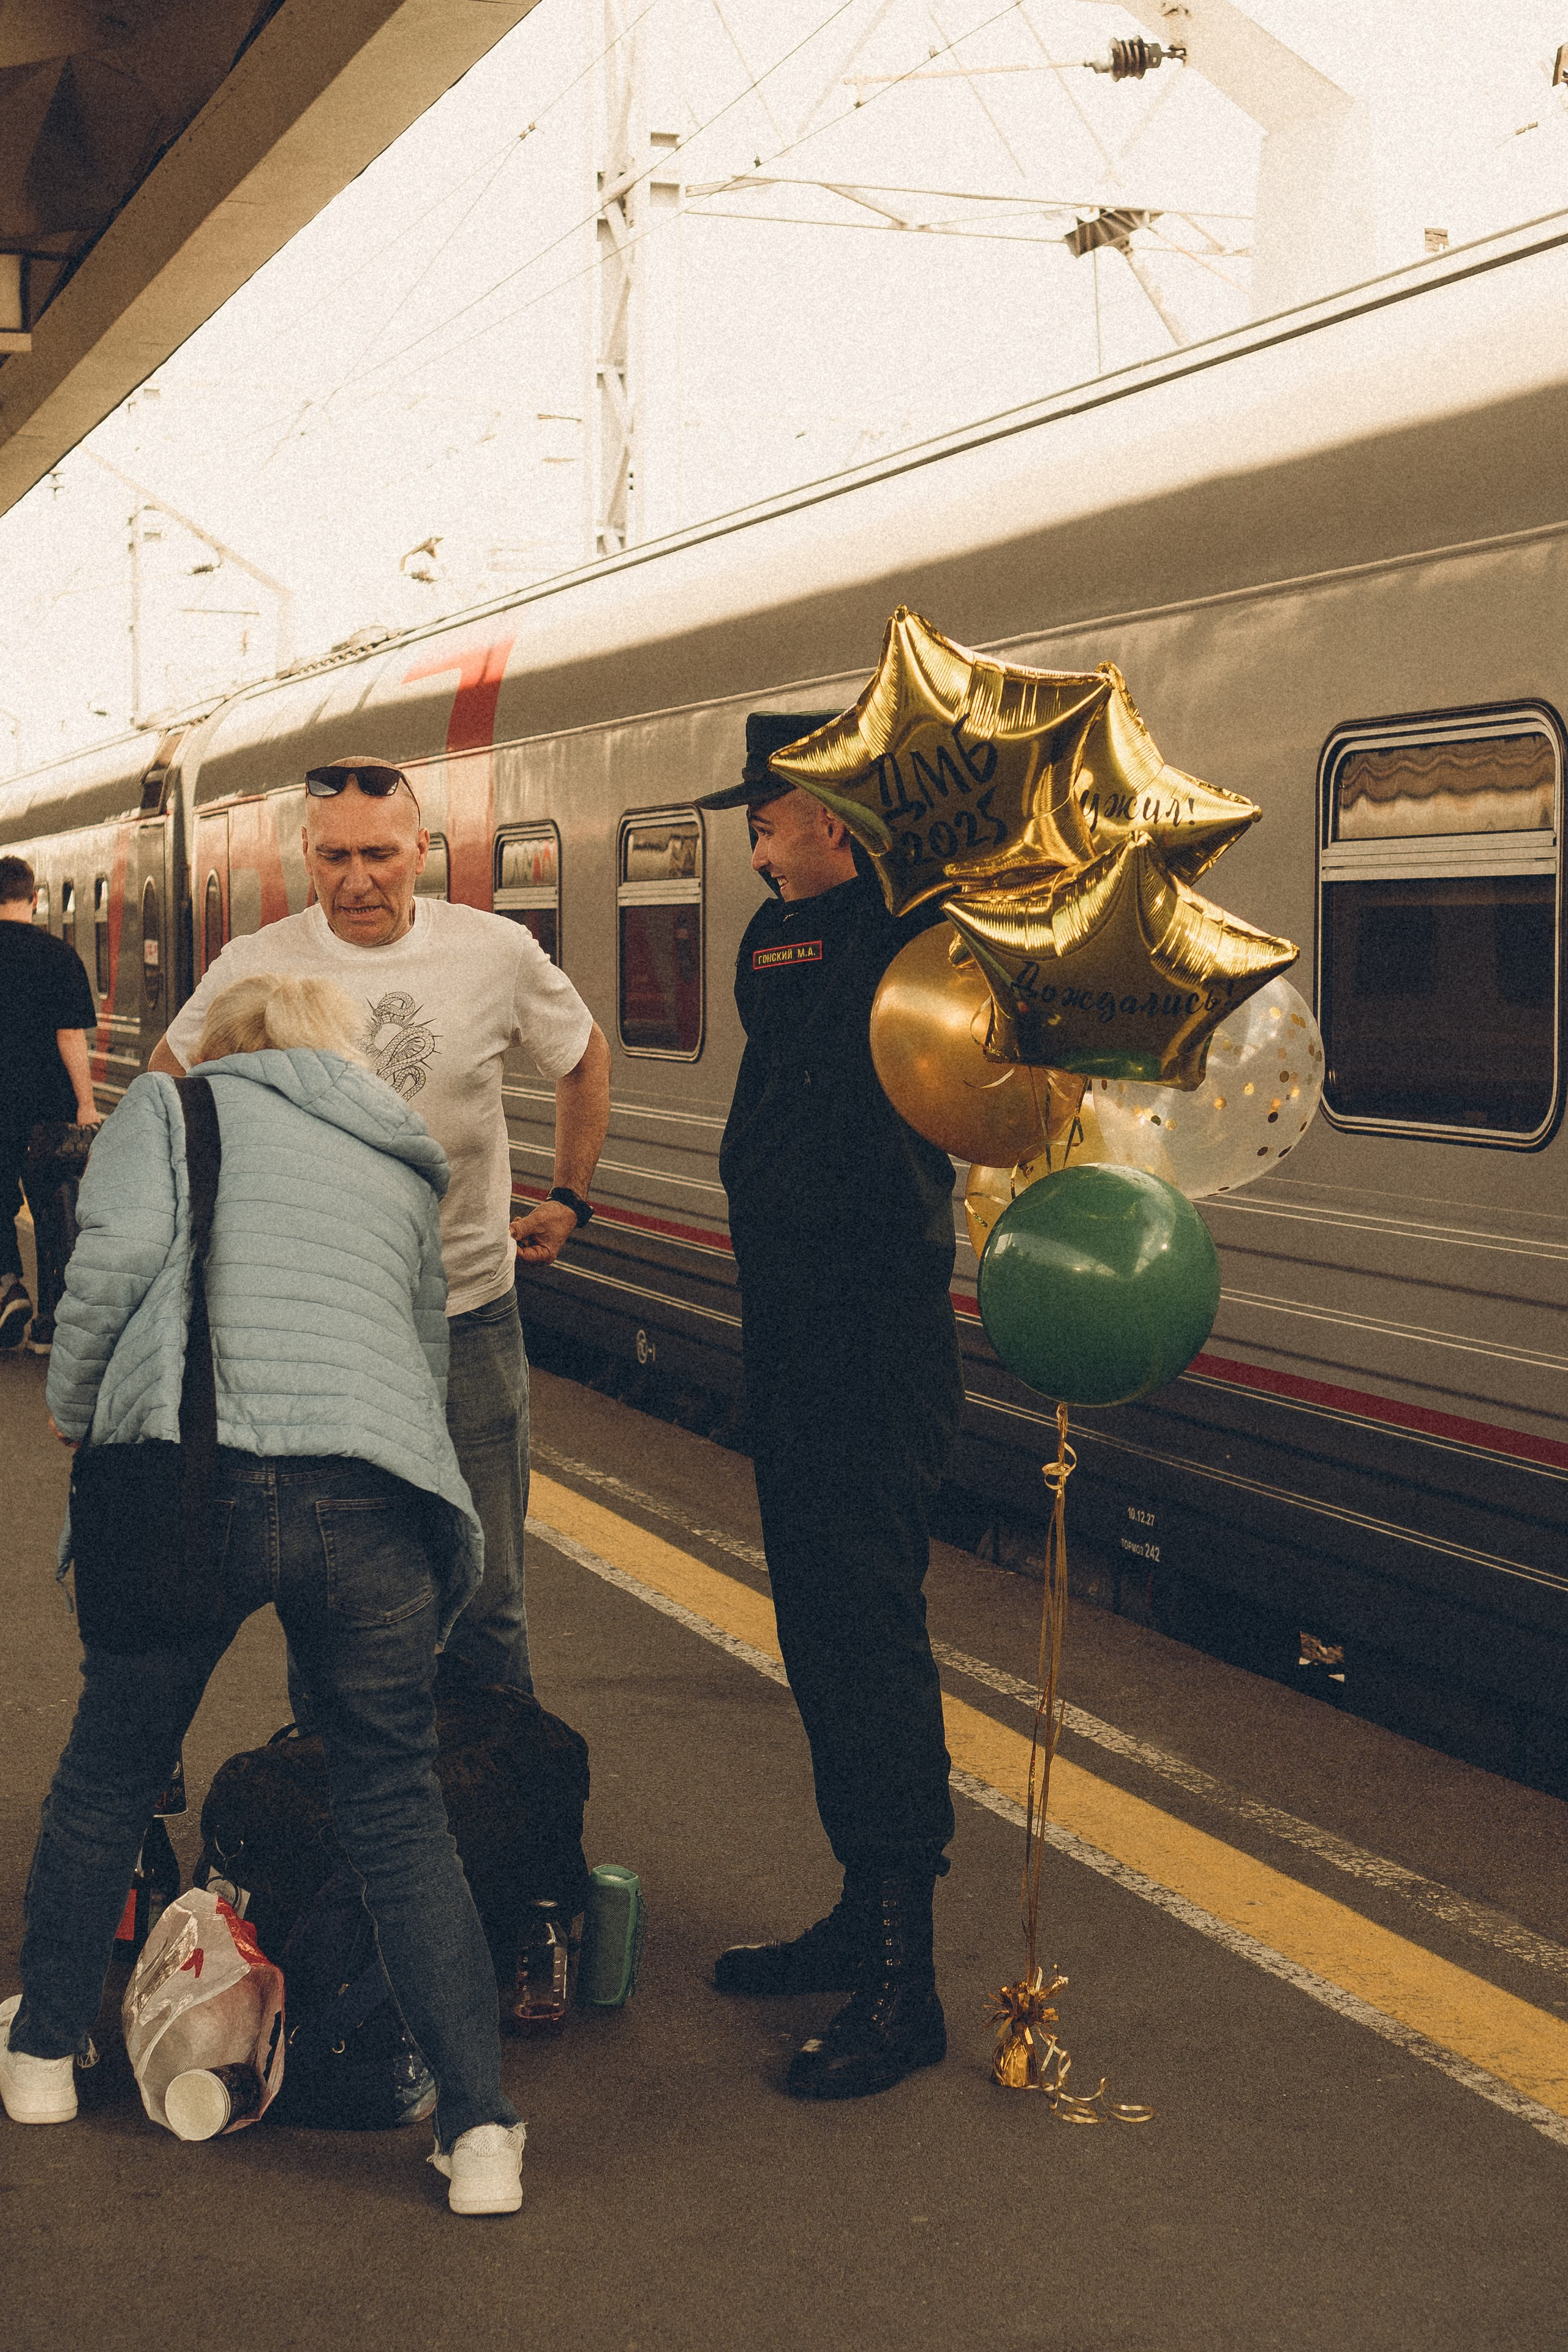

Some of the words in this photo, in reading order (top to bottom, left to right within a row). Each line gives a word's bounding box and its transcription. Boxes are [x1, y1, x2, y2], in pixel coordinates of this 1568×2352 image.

[869, 712, 998, 831] ДМБ
[899, 785, 1008, 866] 2025
[1079, 789, 1195, 834] ужил!
[758, 948, 793, 964] ГОНСКИЙ
[797, 947, 816, 959] М.А.
[1011, 960, 1234, 1023] Дождались!
[1128, 1507, 1155, 1526] 10.12.27
[1121, 1539, 1144, 1556] ТОРМОЗ
[1145, 1543, 1160, 1562] 242
